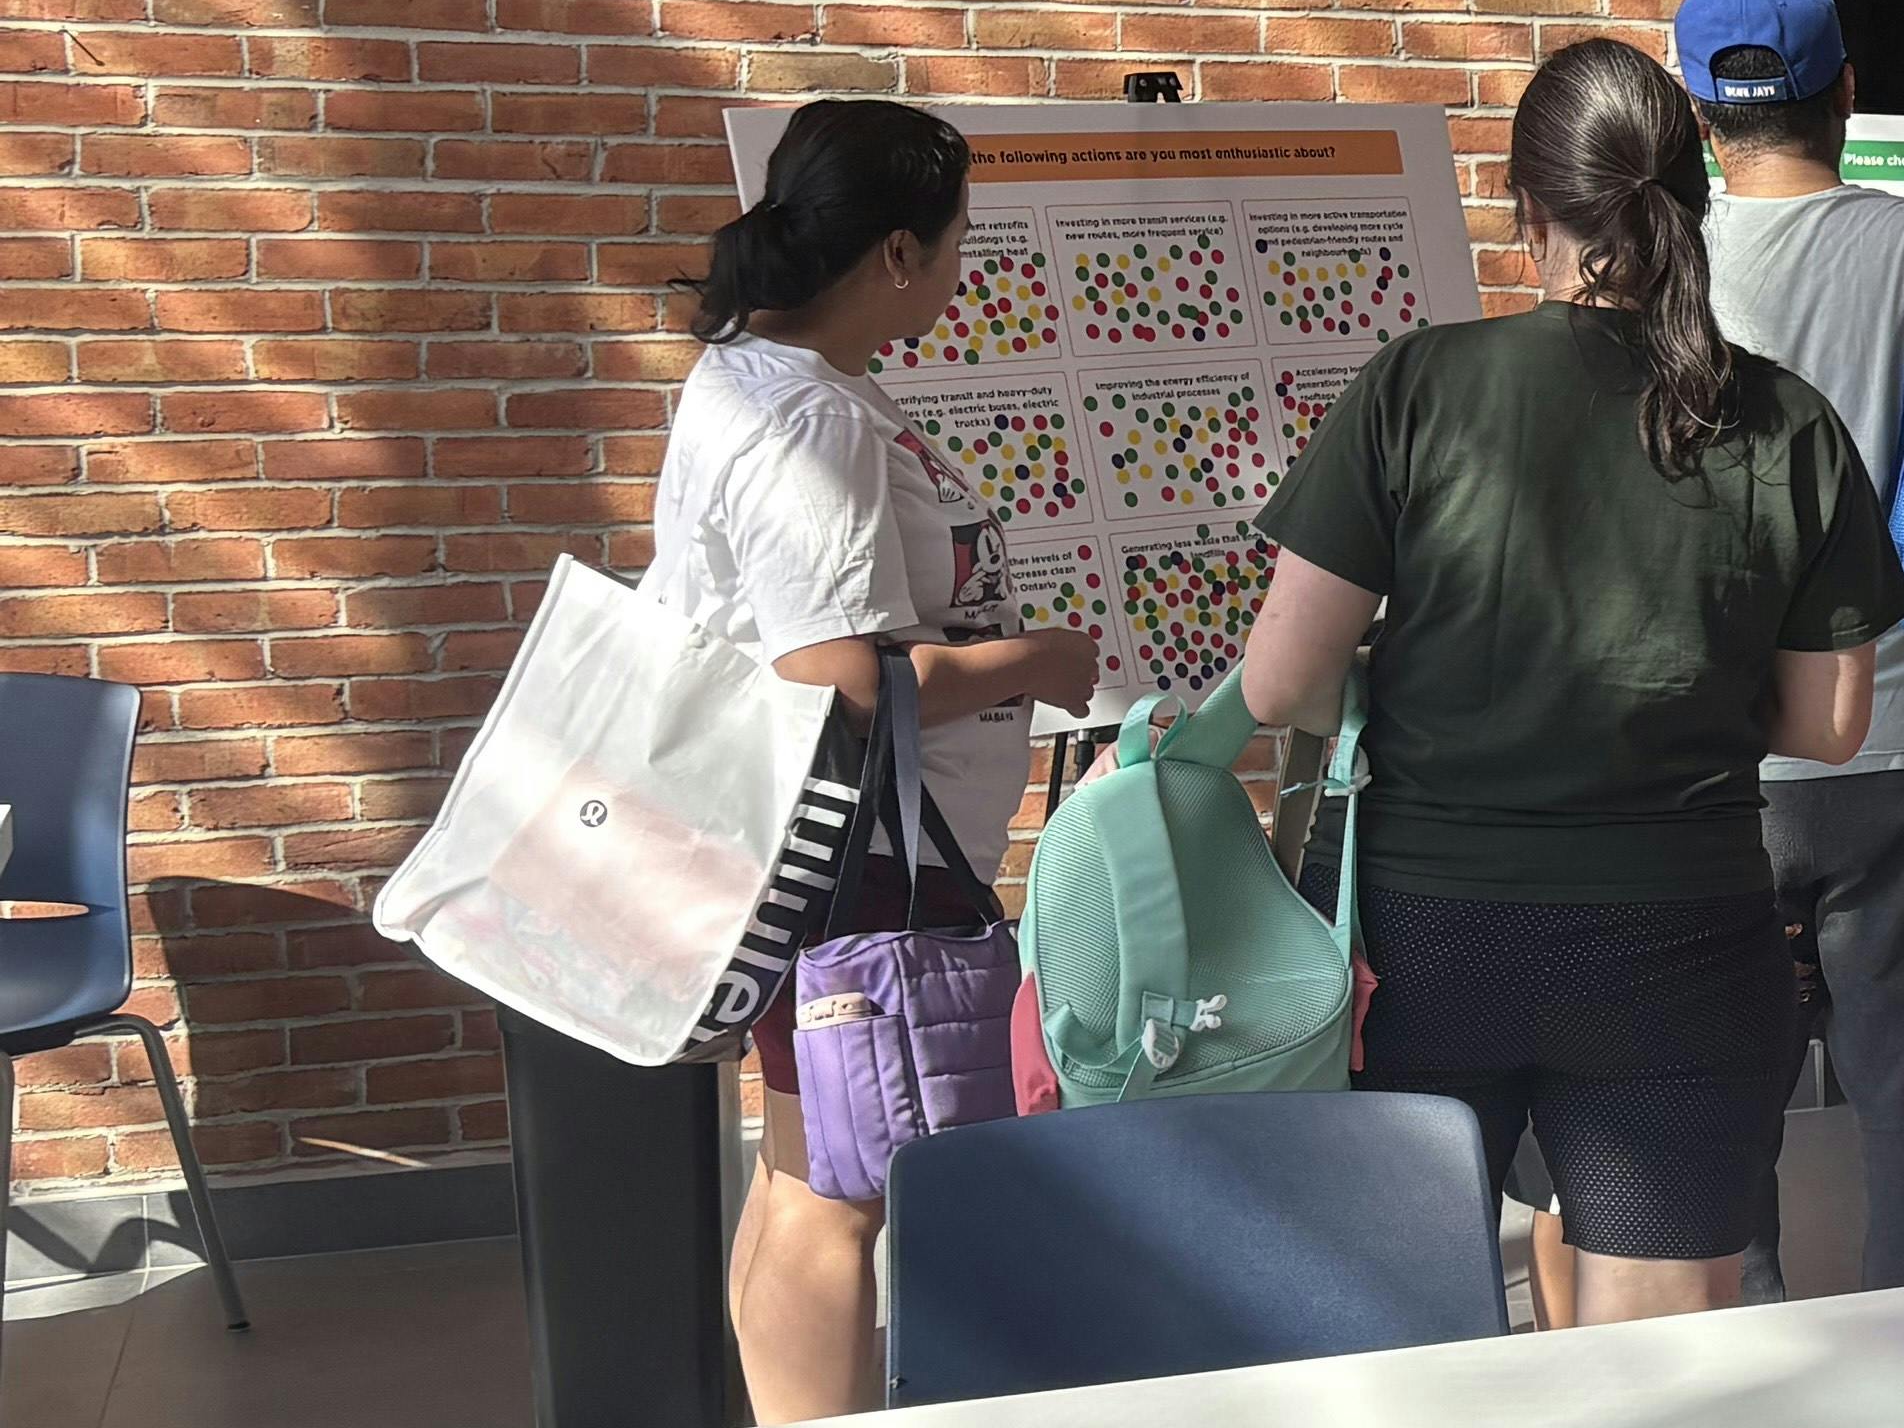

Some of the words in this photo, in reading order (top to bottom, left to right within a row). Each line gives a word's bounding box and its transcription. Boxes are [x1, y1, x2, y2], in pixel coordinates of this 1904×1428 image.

[1752, 83, 1776, 97] JAYS
[970, 150, 996, 164] the
[999, 150, 1067, 164] following
[1071, 148, 1122, 161] actions
[1125, 150, 1146, 160] are
[1150, 150, 1176, 162] you
[1179, 148, 1212, 159] most
[1215, 146, 1290, 158] enthusiastic
[1294, 146, 1335, 157] about?
[1843, 153, 1884, 165] Please
[1019, 581, 1057, 591] Ontario
